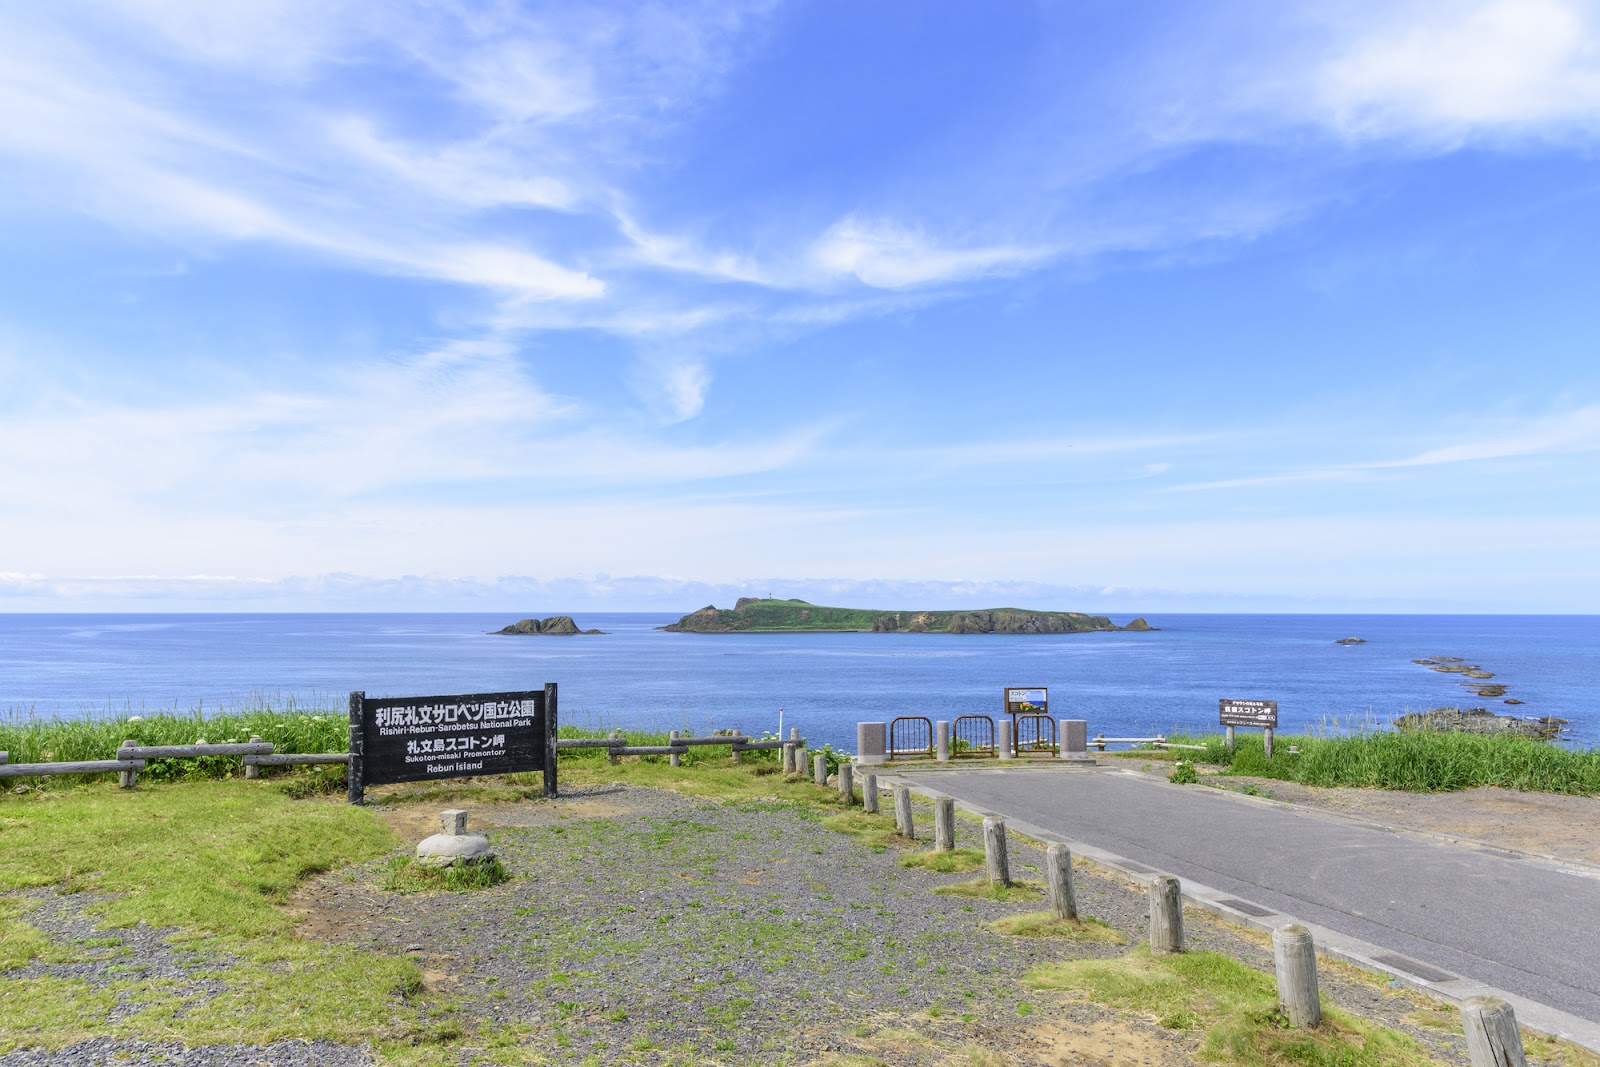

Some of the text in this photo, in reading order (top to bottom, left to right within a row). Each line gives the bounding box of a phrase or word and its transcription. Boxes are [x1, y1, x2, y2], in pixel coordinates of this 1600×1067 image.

[375, 700, 535, 727] 利尻礼文サロベツ国立公園
[380, 719, 531, 735] Rishiri-Rebun-Sarobetsu National Park
[407, 734, 505, 754] 礼文島スコトン岬
[405, 749, 506, 763] Sukoton-misaki Promontory
[427, 764, 454, 773] Rebun
